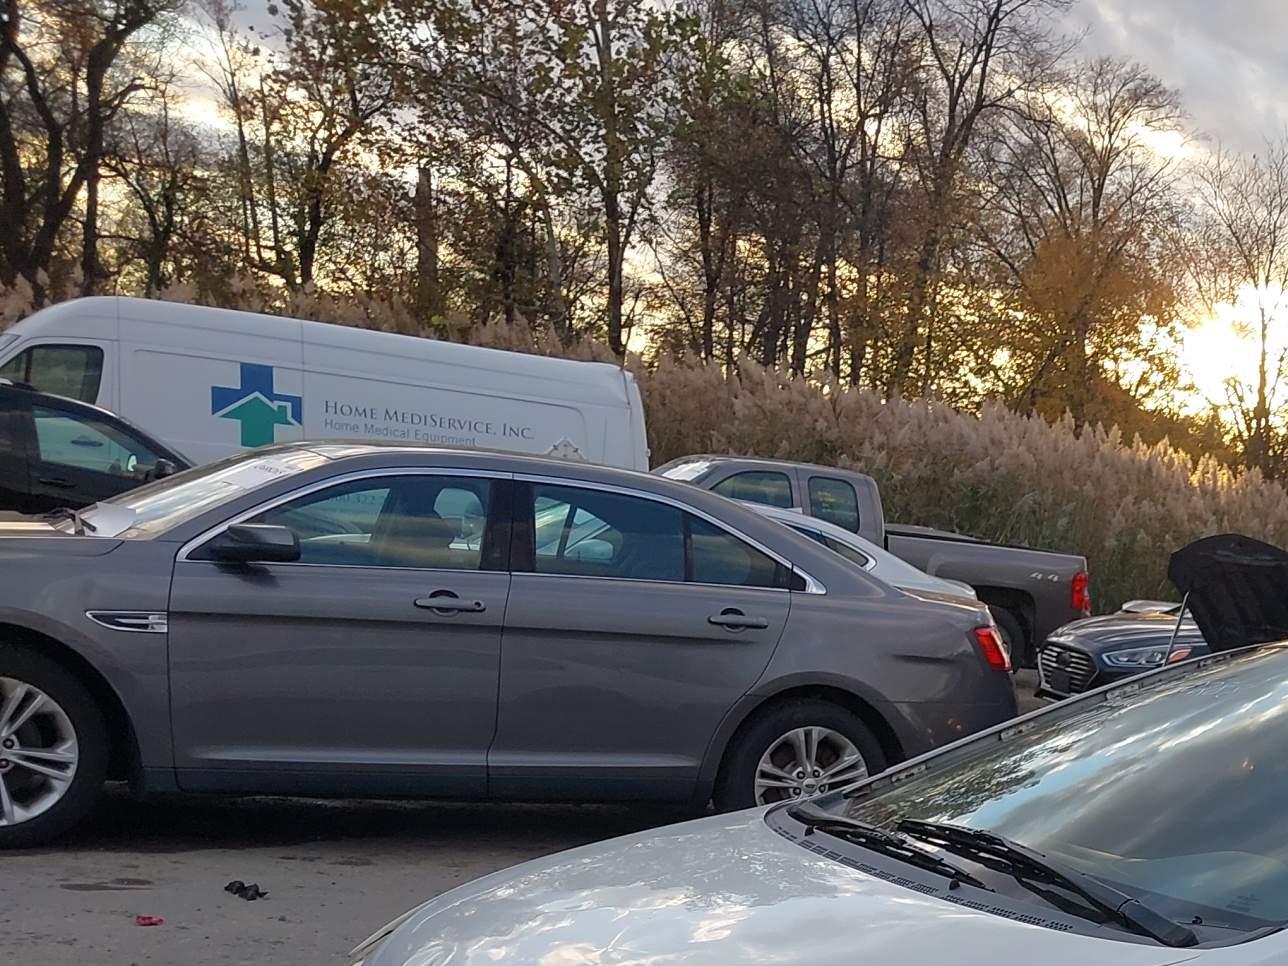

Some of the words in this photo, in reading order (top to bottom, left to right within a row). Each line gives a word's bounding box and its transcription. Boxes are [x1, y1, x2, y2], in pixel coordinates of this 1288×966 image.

[324, 418, 360, 433] Home
[363, 423, 410, 440] Medical
[414, 429, 477, 448] Equipment
